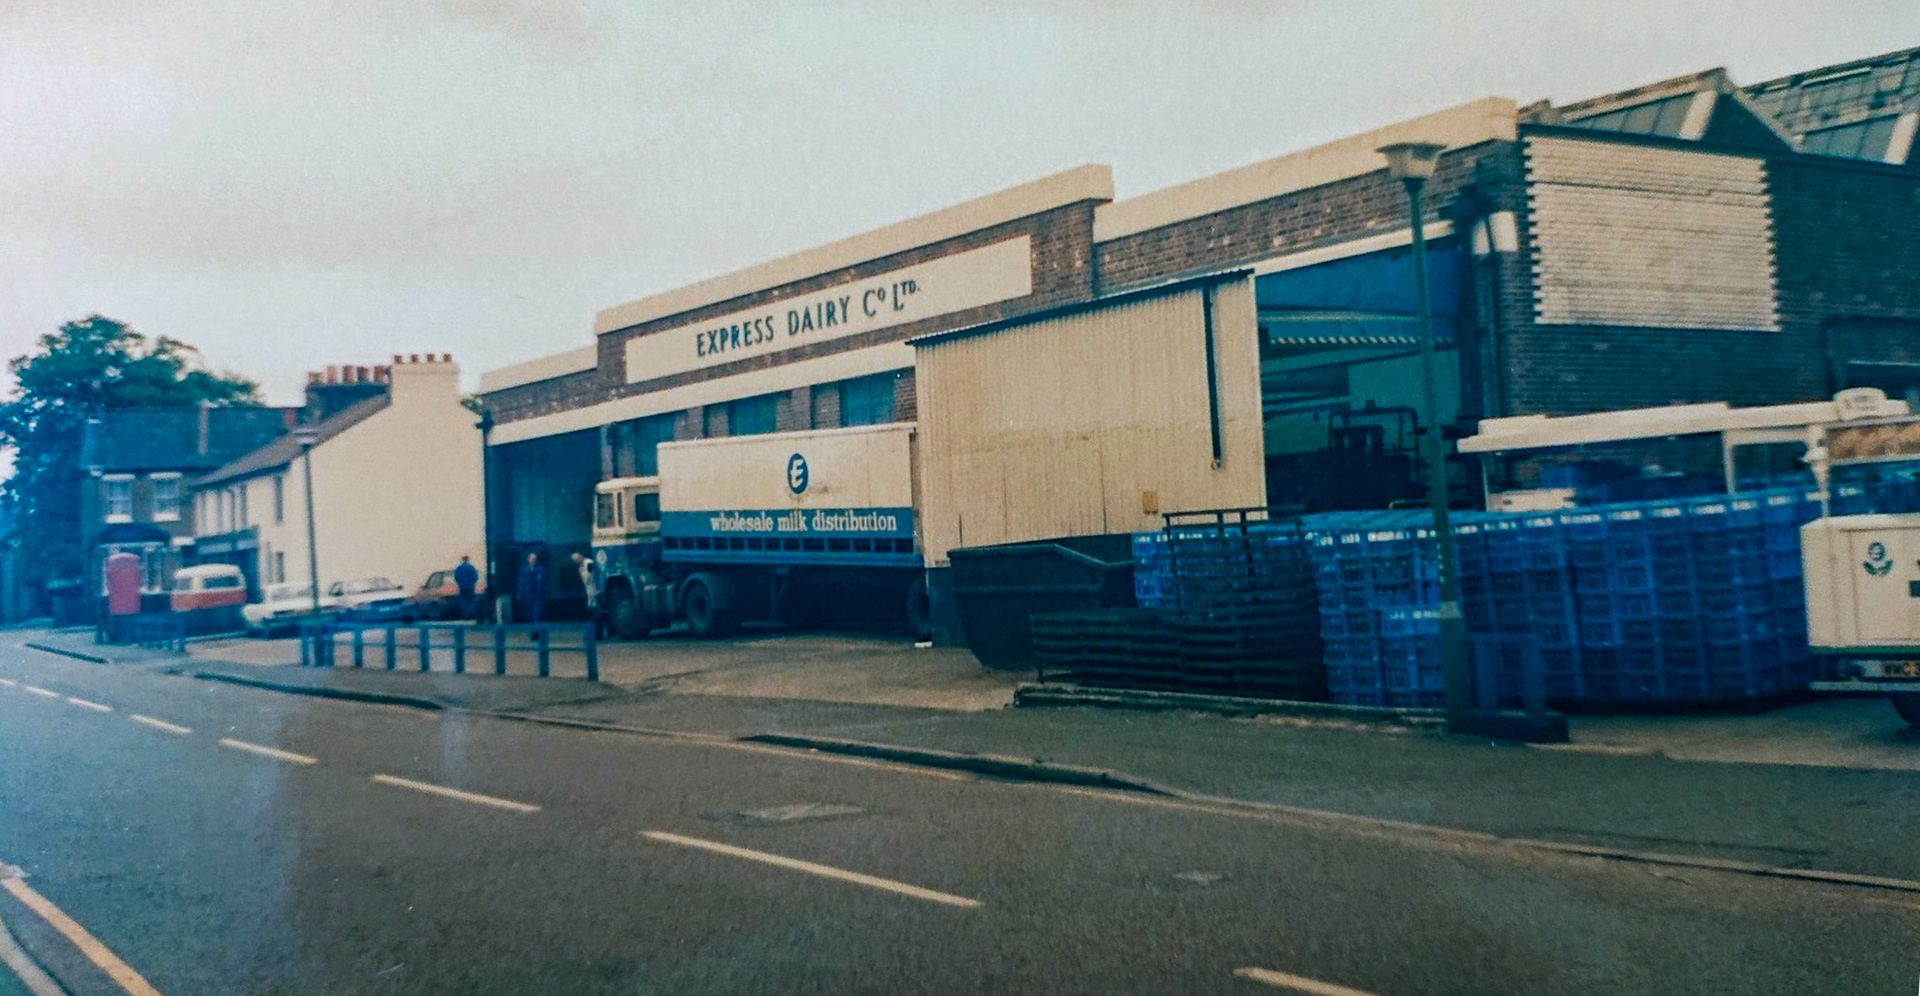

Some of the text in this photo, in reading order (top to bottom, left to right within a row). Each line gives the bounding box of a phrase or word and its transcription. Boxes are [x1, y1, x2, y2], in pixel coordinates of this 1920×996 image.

[697, 316, 774, 357] EXPRESS
[788, 297, 850, 335] DAIRY
[711, 510, 896, 532] wholesale milk distribution
